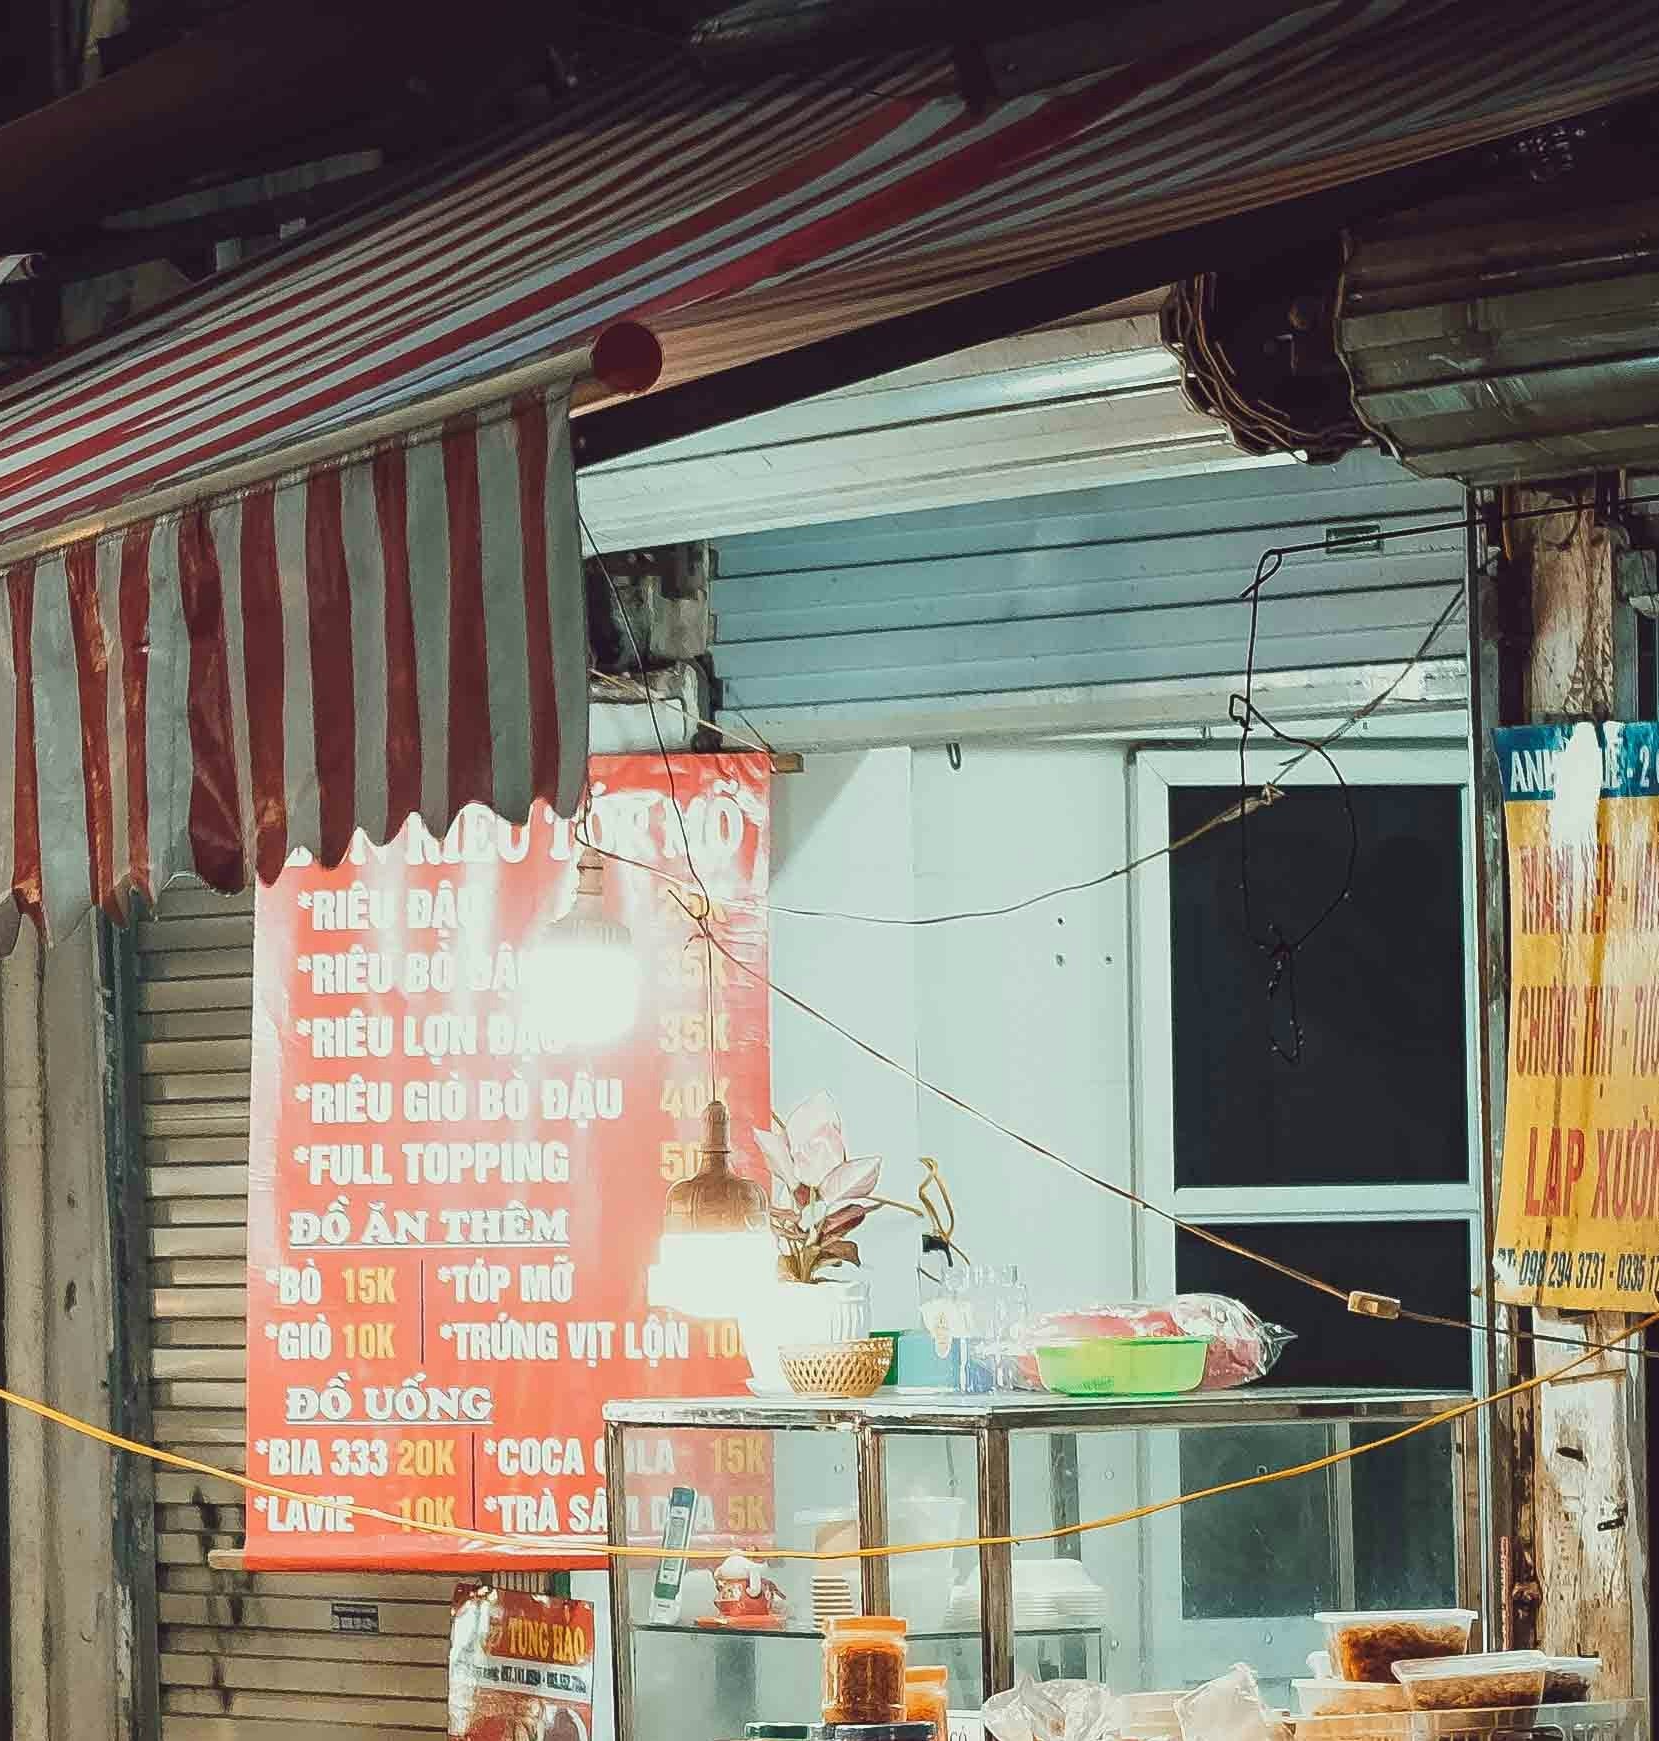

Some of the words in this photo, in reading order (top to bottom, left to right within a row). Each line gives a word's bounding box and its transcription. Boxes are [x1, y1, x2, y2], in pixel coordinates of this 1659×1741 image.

[311, 944, 393, 993] RIÊU
[311, 1007, 393, 1057] RIÊU
[309, 1071, 391, 1122] RIÊU
[403, 1072, 468, 1121] GIÒ
[480, 1071, 531, 1121] BÒ
[542, 1064, 623, 1129] ĐẬU
[308, 1145, 393, 1185] FULL
[401, 1143, 569, 1184] TOPPING
[289, 1195, 350, 1244] ĐỒ
[439, 1200, 569, 1244] THÊM
[279, 1259, 321, 1304] BÒ
[341, 1267, 396, 1304] 15K
[451, 1259, 510, 1303] TÓP
[278, 1314, 331, 1360] GIÒ
[341, 1322, 395, 1360] 10K
[567, 1322, 617, 1368] VỊT
[625, 1311, 688, 1368] LỘN
[286, 1370, 350, 1421] ĐỒ
[362, 1370, 494, 1421] UỐNG
[268, 1440, 323, 1476] BIA
[330, 1440, 389, 1476] 333
[396, 1440, 455, 1476] 20K
[497, 1440, 585, 1476] COCA
[711, 1436, 765, 1476] 15K
[266, 1496, 355, 1533] LAVIE
[399, 1496, 455, 1533] 10K
[499, 1486, 560, 1533] TRÀ
[727, 1495, 767, 1532] 5K
